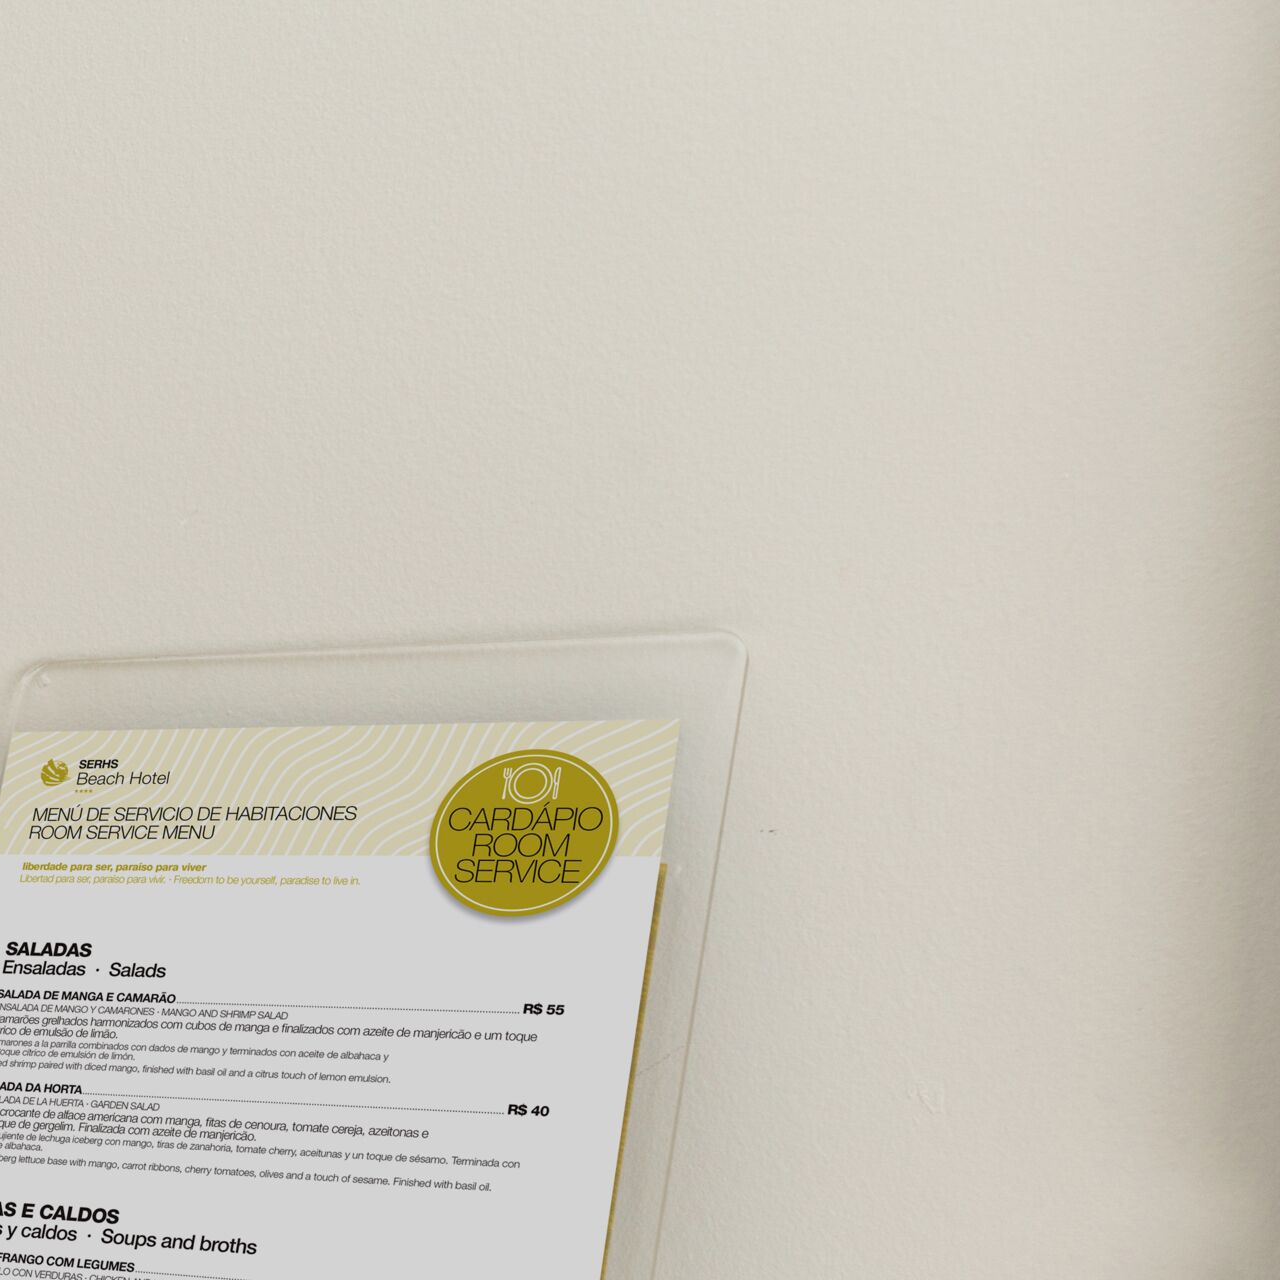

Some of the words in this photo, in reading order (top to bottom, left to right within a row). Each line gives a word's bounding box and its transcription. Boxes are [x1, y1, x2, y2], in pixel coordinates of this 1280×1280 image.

[78, 758, 119, 770] SERHS
[76, 771, 125, 786] Beach
[129, 771, 171, 785] Hotel
[32, 803, 84, 822] MENÚ
[86, 807, 111, 822] DE
[113, 806, 194, 822] SERVICIO
[196, 806, 223, 822] DE
[225, 805, 358, 822] HABITACIONES
[448, 801, 604, 832] CARDÁPIO
[28, 825, 83, 840] ROOM
[85, 824, 160, 840] SERVICE
[161, 824, 216, 840] MENU
[471, 832, 571, 858] ROOM
[22, 861, 69, 871] liberdade
[69, 863, 93, 873] para
[95, 864, 113, 872] ser,
[115, 863, 154, 873] paraíso
[155, 864, 179, 873] para
[181, 863, 207, 872] viver
[454, 858, 582, 884] SERVICE
[19, 874, 55, 883] Libertad
[55, 875, 75, 884] para
[76, 875, 92, 884] ser,
[93, 874, 126, 884] paraíso
[126, 876, 147, 885] para
[148, 875, 169, 884] vivir.
[173, 874, 214, 885] Freedom
[215, 876, 226, 885] to
[226, 876, 240, 885] be
[240, 875, 277, 886] yourself,
[280, 876, 321, 886] paradise
[321, 876, 332, 885] to
[333, 876, 349, 886] live
[5, 941, 93, 958] SALADAS
[2, 959, 87, 977] Ensaladas
[108, 961, 167, 979] Salads
[40, 1003, 54, 1013] DE
[54, 1004, 89, 1014] MANGO
[90, 1005, 98, 1014] Y
[97, 1005, 156, 1016] CAMARONES
[160, 1007, 198, 1018] MANGO
[197, 1009, 219, 1019] AND
[219, 1009, 257, 1019] SHRIMP
[257, 1010, 289, 1021] SALAD
[42, 990, 60, 1001] DE
[60, 990, 104, 1002] MANGA
[105, 991, 115, 1002] E
[116, 991, 177, 1004] CAMARÃO
[522, 1002, 544, 1016] R$
[545, 1004, 565, 1016] 55
[24, 1082, 42, 1093] DA
[43, 1083, 83, 1095] HORTA
[507, 1103, 528, 1117] R$
[530, 1105, 550, 1117] 40
[20, 1202, 36, 1219] E
[39, 1203, 120, 1225] CALDOS
[5, 1225, 18, 1241] y
[20, 1223, 78, 1242] caldos
[100, 1228, 157, 1250] Soups
[160, 1234, 196, 1251] and
[199, 1234, 258, 1255] broths
[46, 1255, 75, 1268] COM
[76, 1258, 136, 1273] LEGUMES
